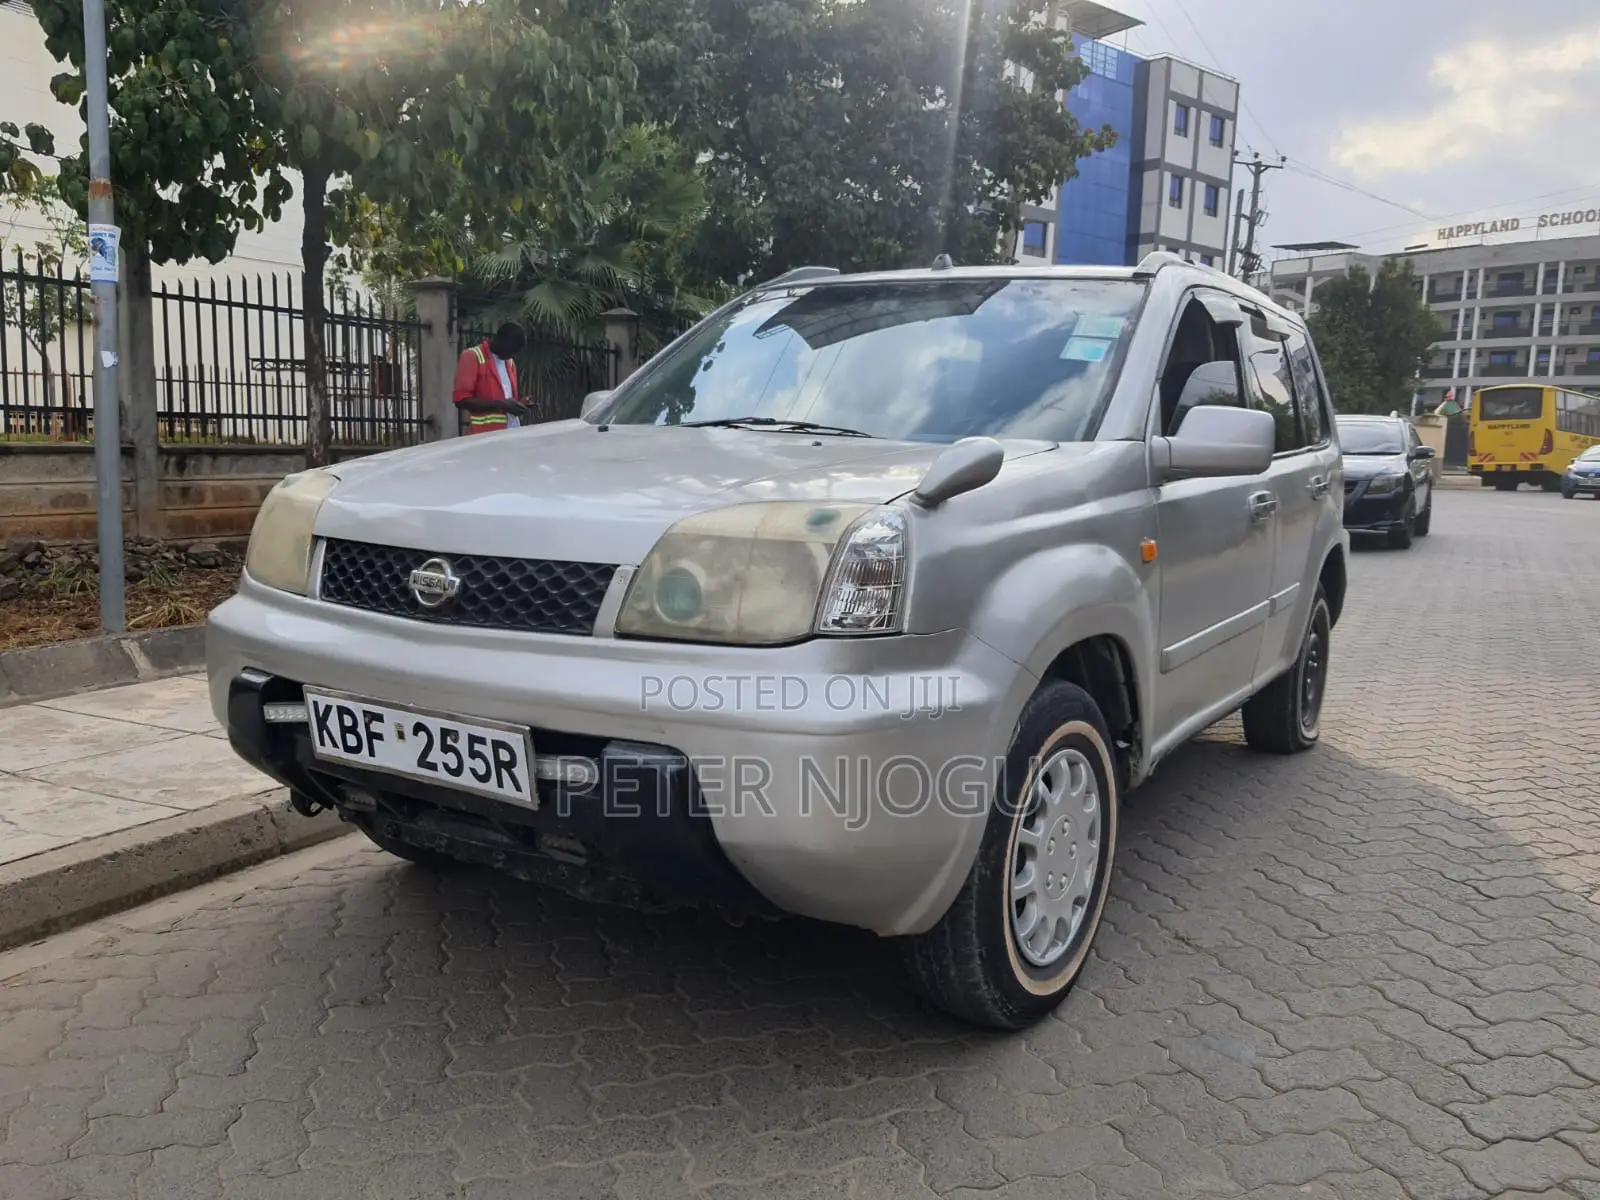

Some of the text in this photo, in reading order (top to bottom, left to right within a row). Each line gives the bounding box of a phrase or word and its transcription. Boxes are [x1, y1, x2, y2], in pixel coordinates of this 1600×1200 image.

[1438, 219, 1520, 240] HAPPYLAND
[412, 572, 453, 592] NISSAN
[312, 700, 523, 793] KBF 255R
